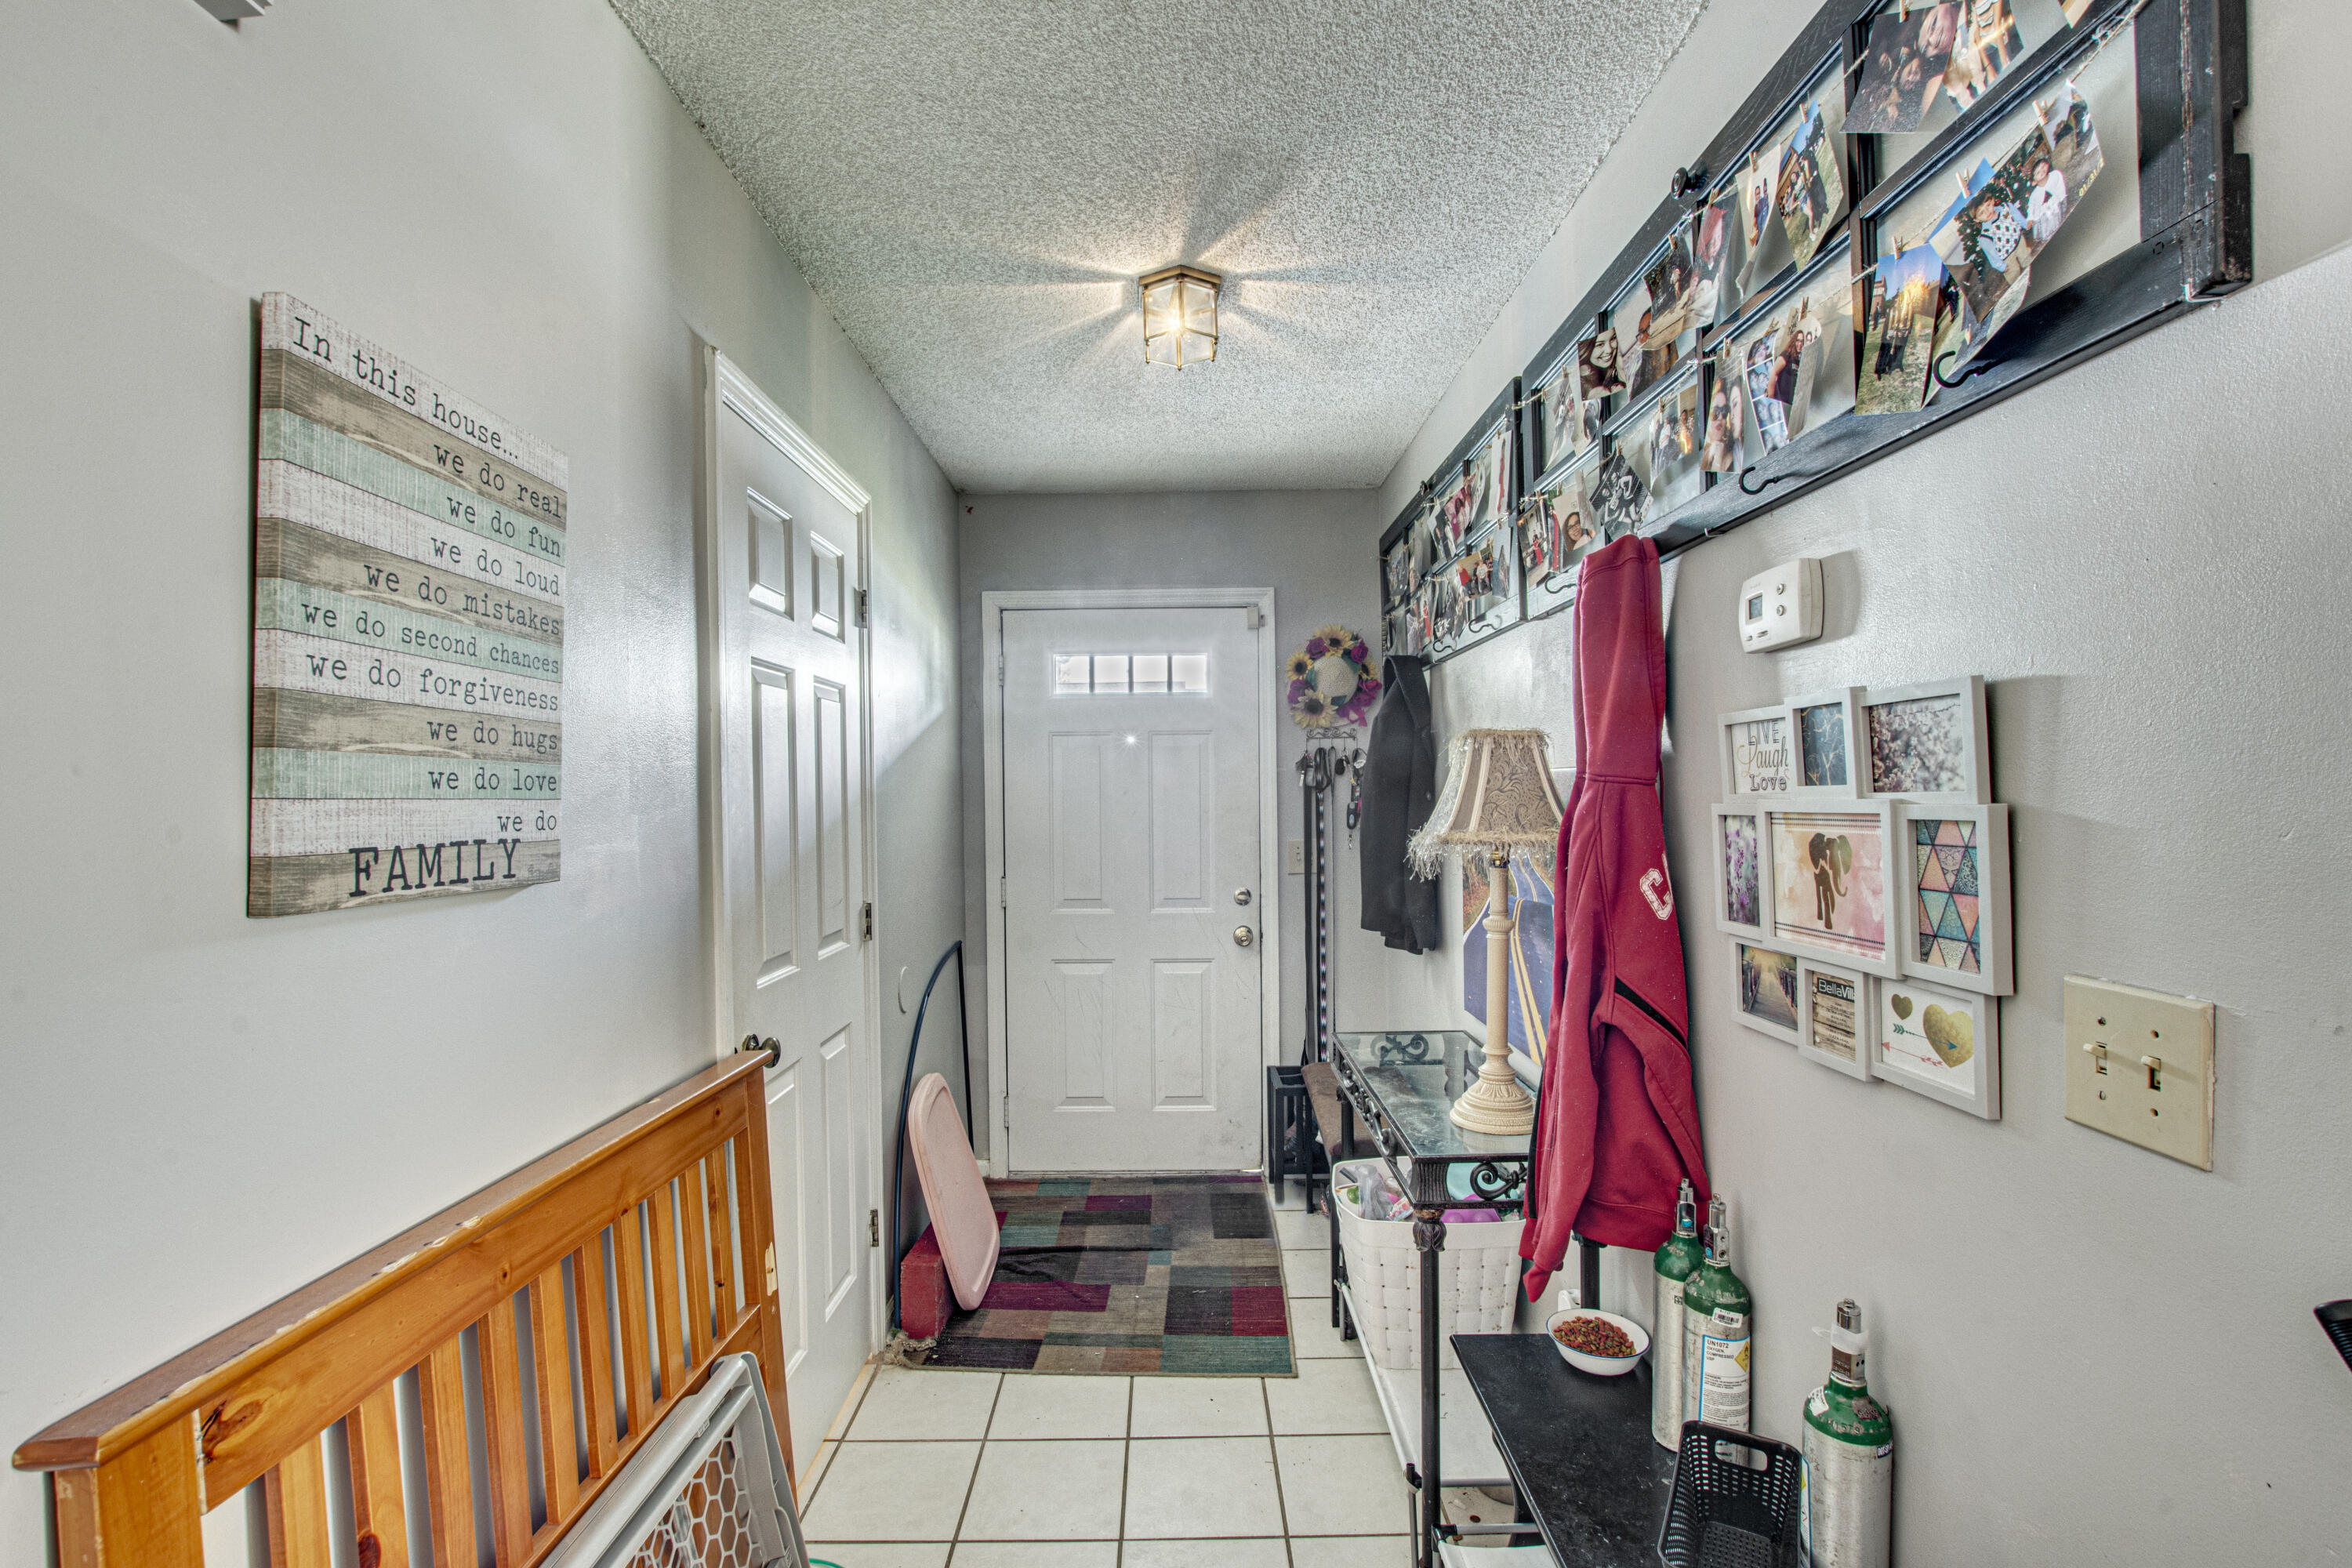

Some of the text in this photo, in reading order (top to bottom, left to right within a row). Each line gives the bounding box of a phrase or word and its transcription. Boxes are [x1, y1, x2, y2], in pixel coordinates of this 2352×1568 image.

[293, 317, 518, 459] In this house...
[433, 445, 561, 518] we do real
[446, 496, 561, 558] we do fun
[430, 537, 560, 597] we do loud
[363, 564, 561, 636] we do mistakes
[301, 604, 559, 674] we do second chances
[306, 654, 558, 712] we do forgiveness
[426, 720, 557, 754] we do hugs
[1737, 735, 1788, 778] Laugh
[1747, 720, 1780, 746] LIVE
[428, 768, 557, 792] we do love
[1749, 774, 1787, 791] Love
[497, 810, 557, 831] we do
[348, 838, 521, 898] FAMILY
[1818, 978, 1855, 1001] BellaVill
[1707, 1339, 1729, 1348] UN1072
